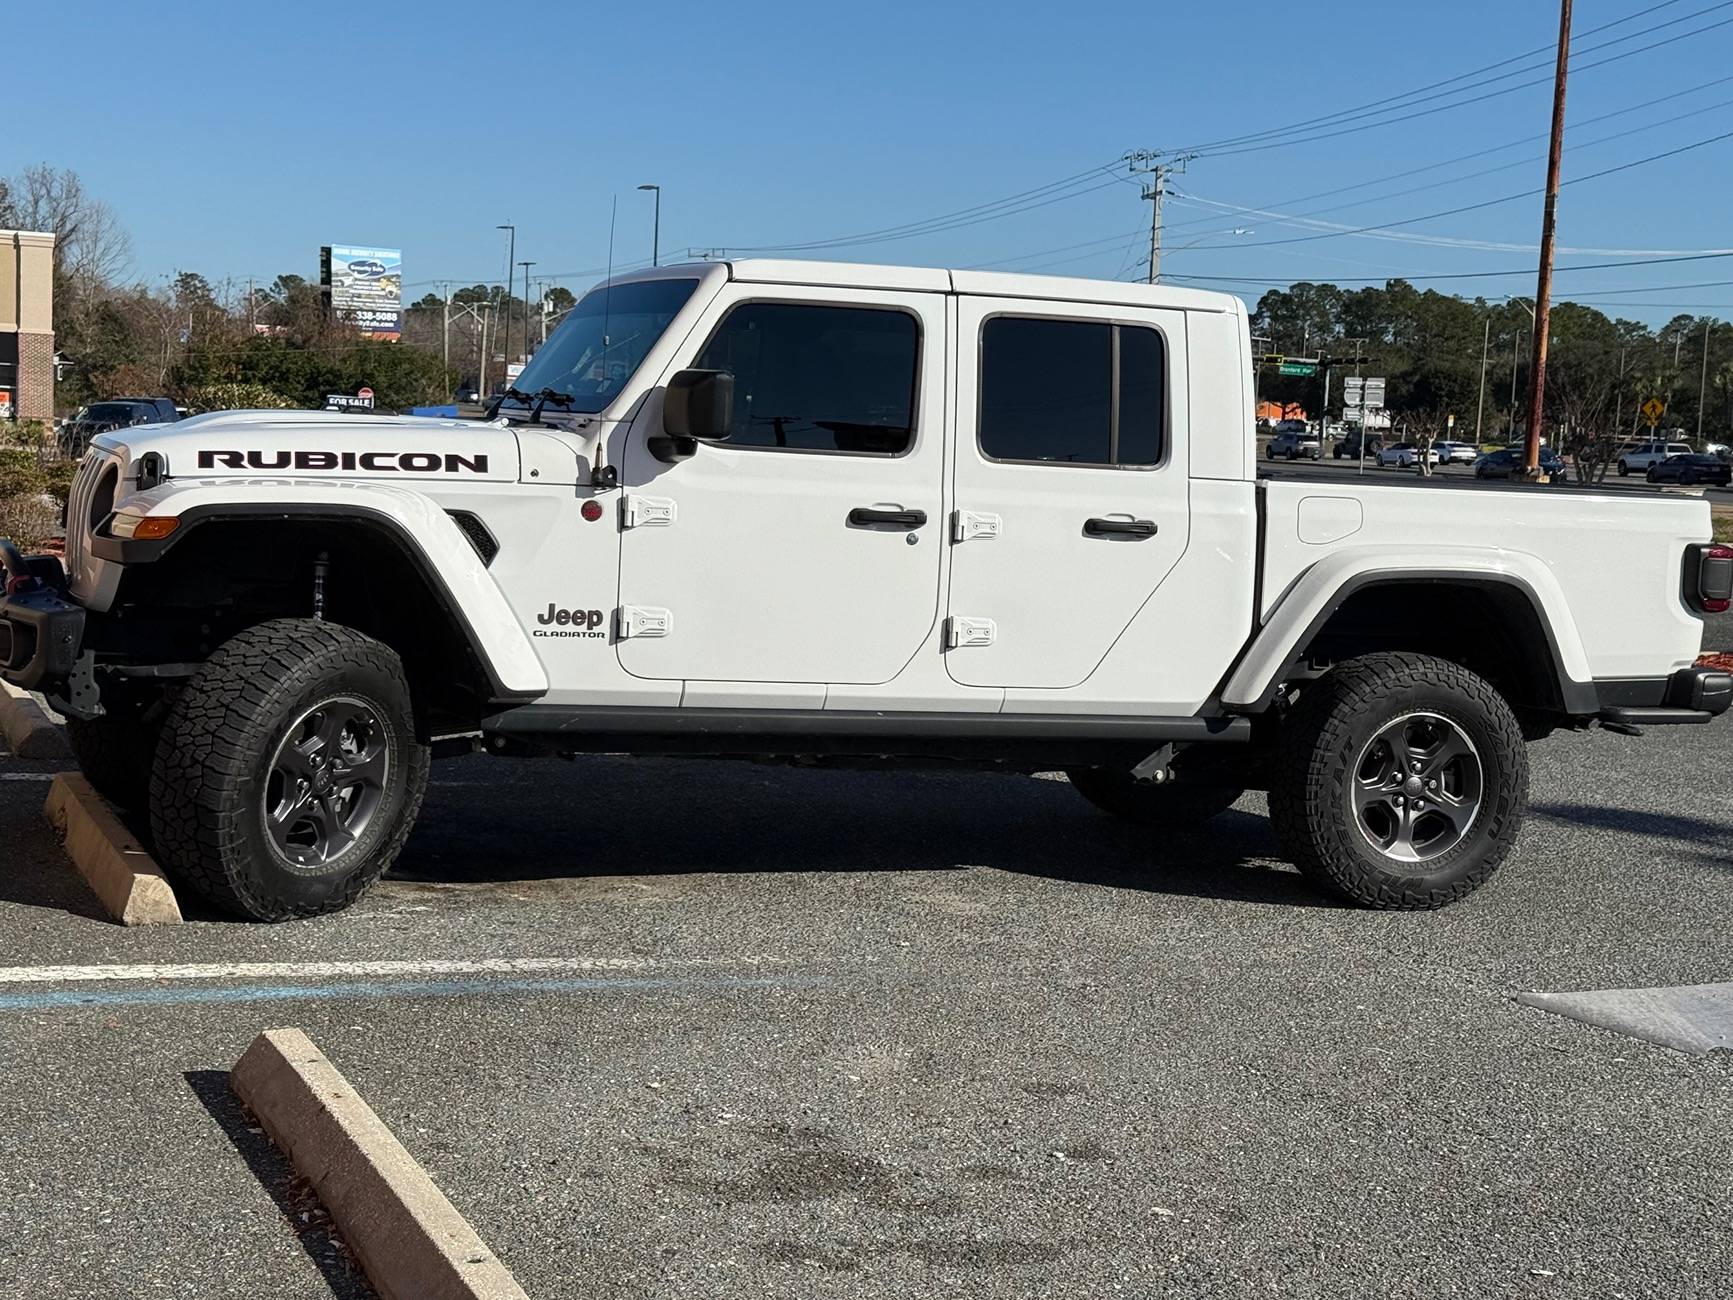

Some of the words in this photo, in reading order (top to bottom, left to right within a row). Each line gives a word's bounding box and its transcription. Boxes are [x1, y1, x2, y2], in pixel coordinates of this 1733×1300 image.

[336, 310, 398, 321] 8-338-5088
[329, 397, 347, 406] FOR
[348, 398, 370, 407] SALE
[197, 450, 488, 473] RUBICON
[537, 603, 603, 630] Jeep
[532, 630, 605, 639] GLADIATOR
